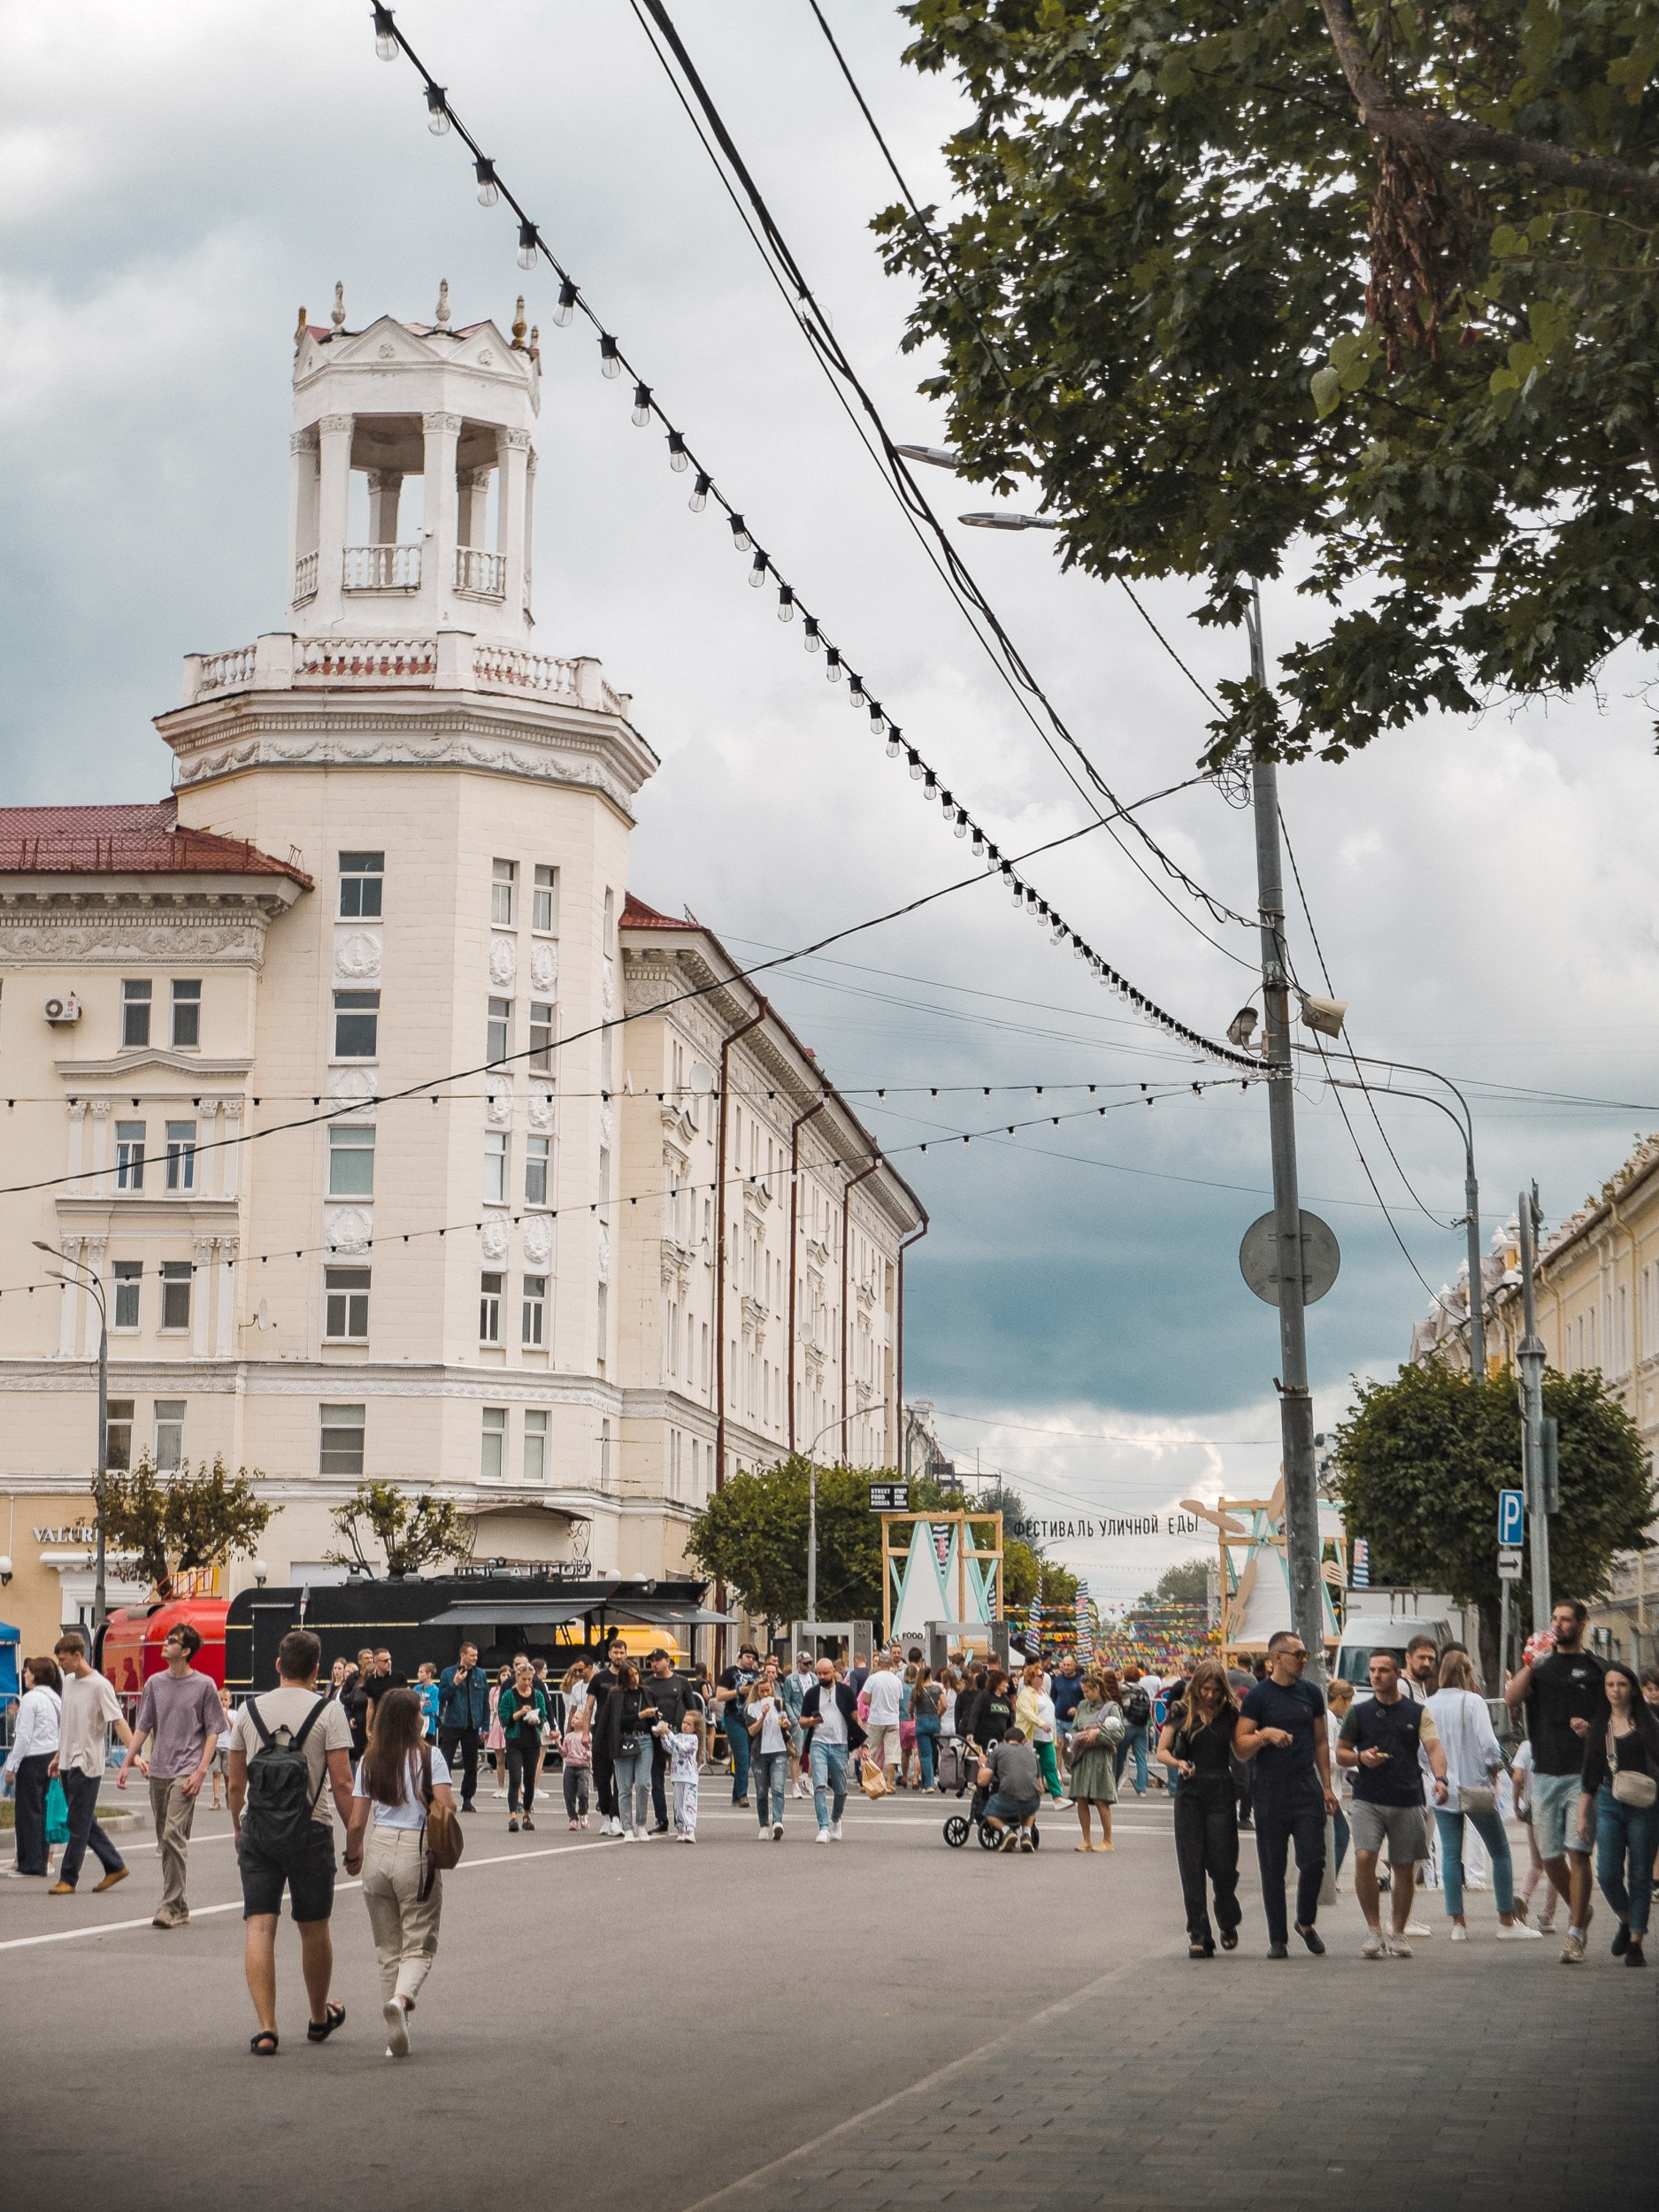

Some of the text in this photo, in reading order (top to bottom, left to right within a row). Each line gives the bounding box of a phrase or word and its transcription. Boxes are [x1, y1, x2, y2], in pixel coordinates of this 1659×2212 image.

[1013, 1514, 1198, 1538] ФЕСТИВАЛЬ УЛИЧНОЙ ЕДЫ
[1504, 1494, 1520, 1541] P
